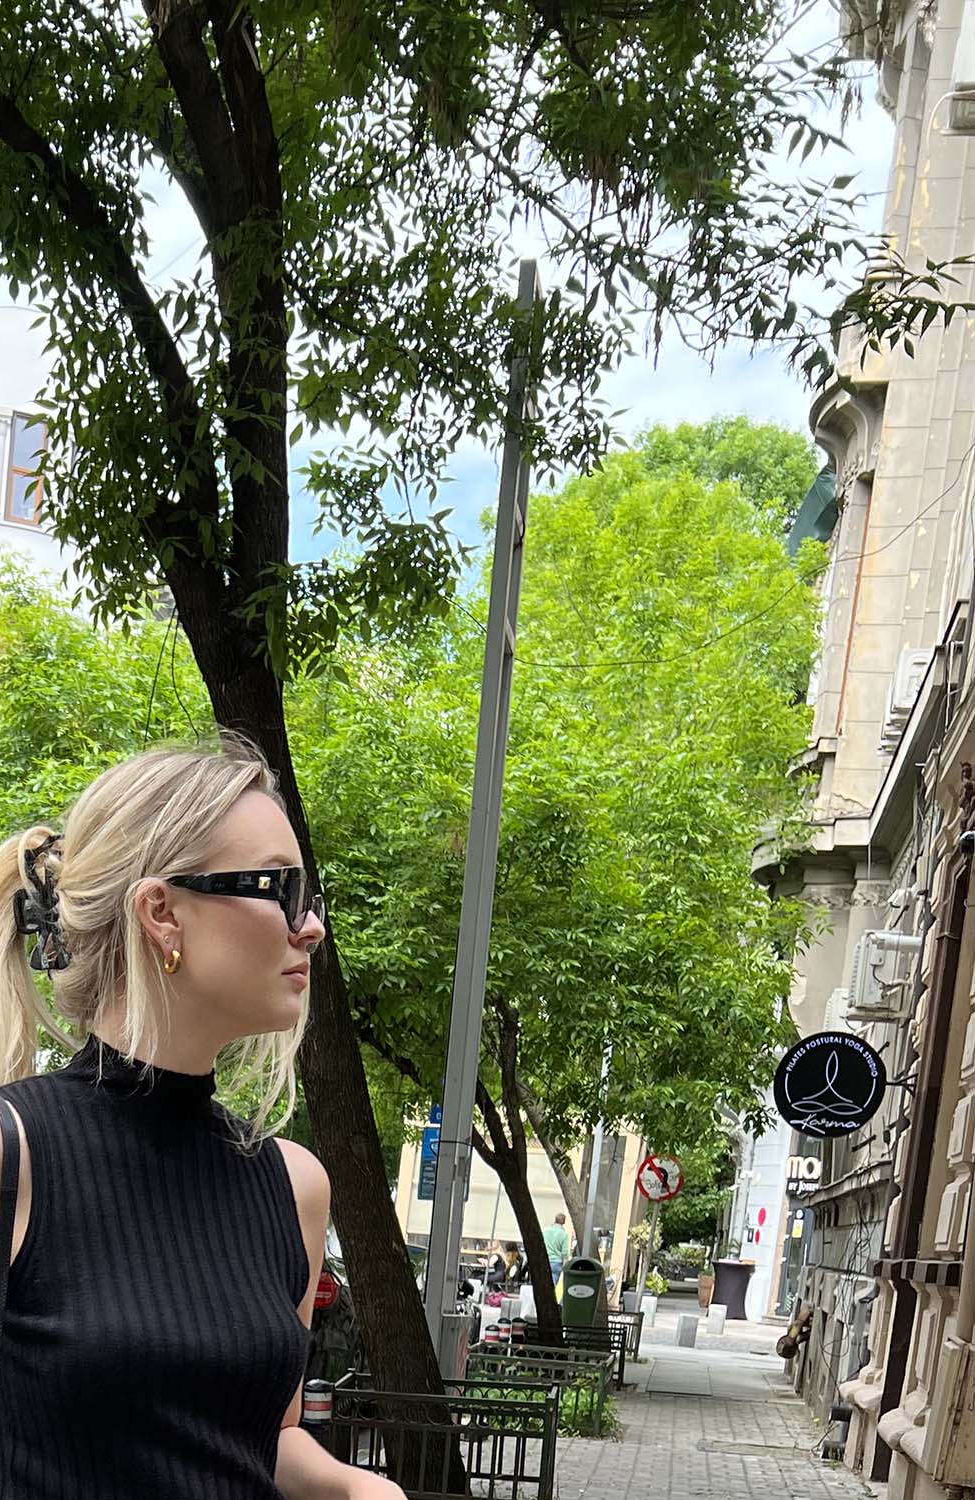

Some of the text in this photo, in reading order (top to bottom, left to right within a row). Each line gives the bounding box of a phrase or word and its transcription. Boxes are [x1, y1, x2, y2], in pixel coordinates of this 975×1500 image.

[786, 1047, 806, 1072] PILATES
[845, 1037, 864, 1053] YOGA
[863, 1051, 878, 1077] STUDIO
[789, 1113, 861, 1135] Karma
